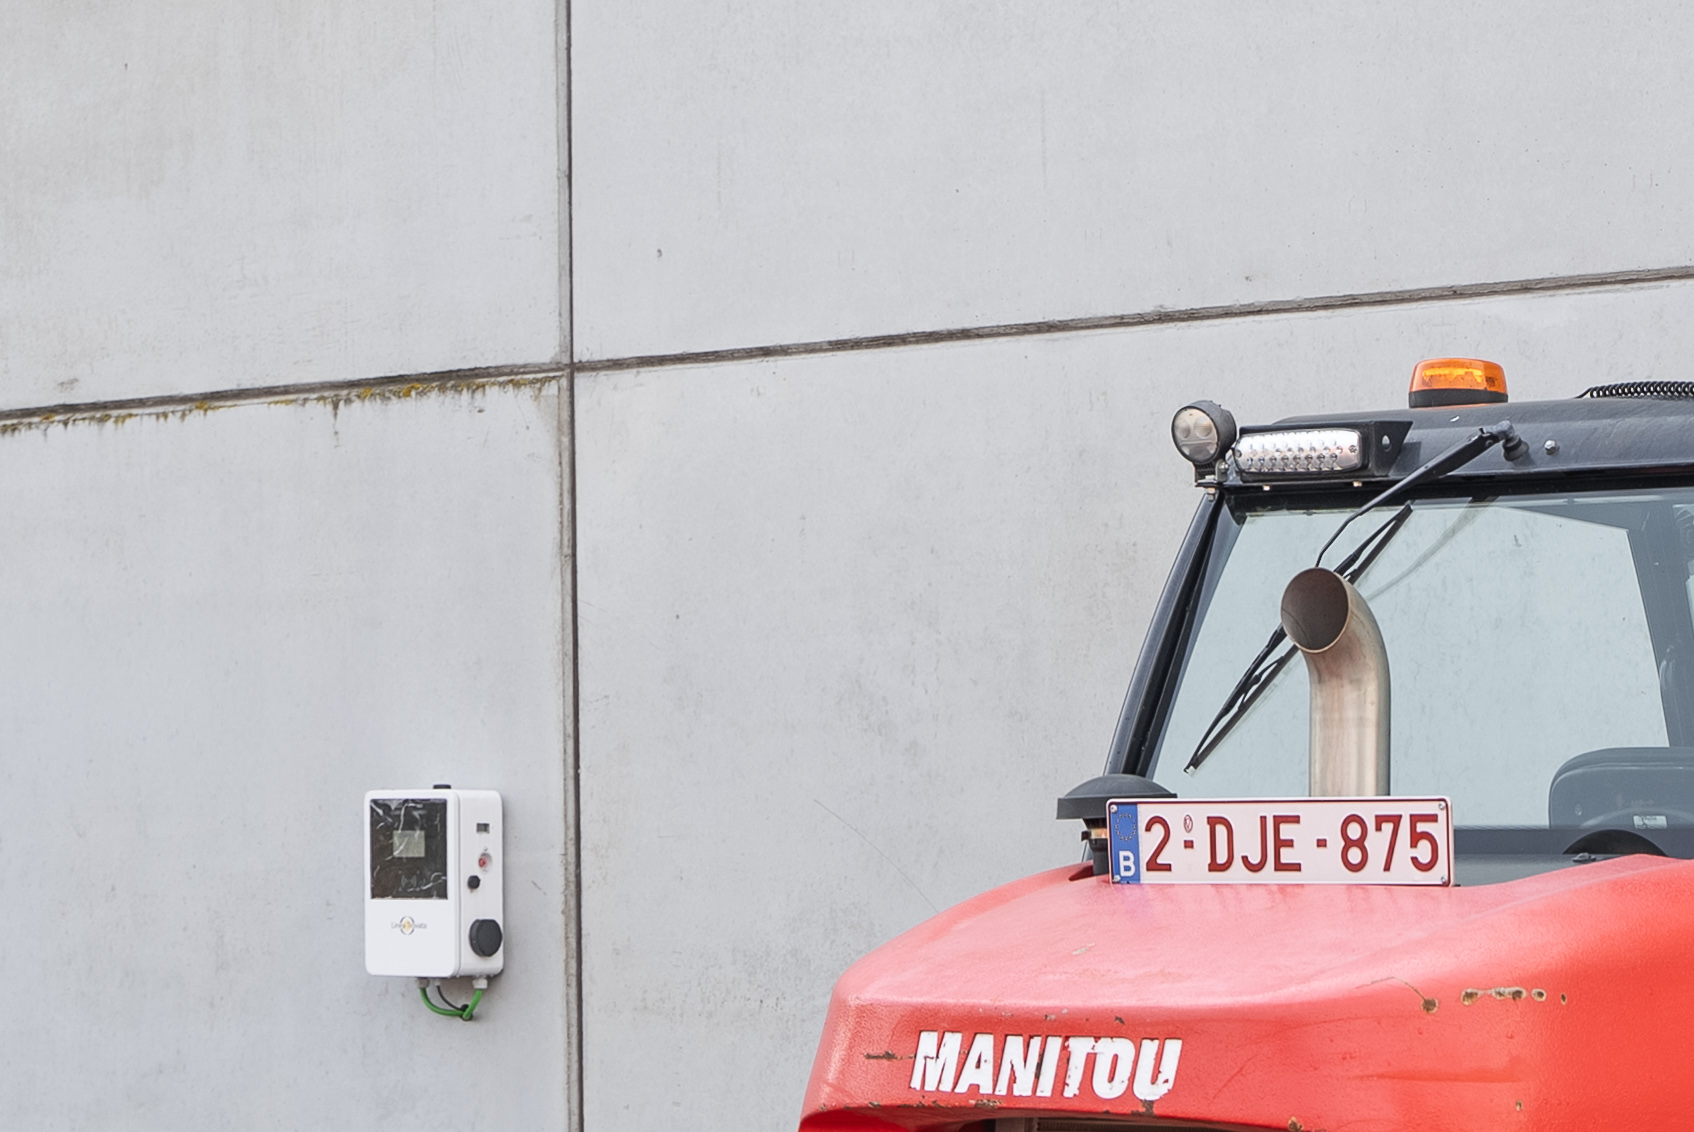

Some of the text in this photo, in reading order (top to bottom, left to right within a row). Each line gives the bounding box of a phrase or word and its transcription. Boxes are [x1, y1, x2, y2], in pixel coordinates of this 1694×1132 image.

[1118, 850, 1136, 877] B
[1143, 813, 1440, 873] 2-DJE-875
[908, 1030, 1183, 1101] MANITOU
